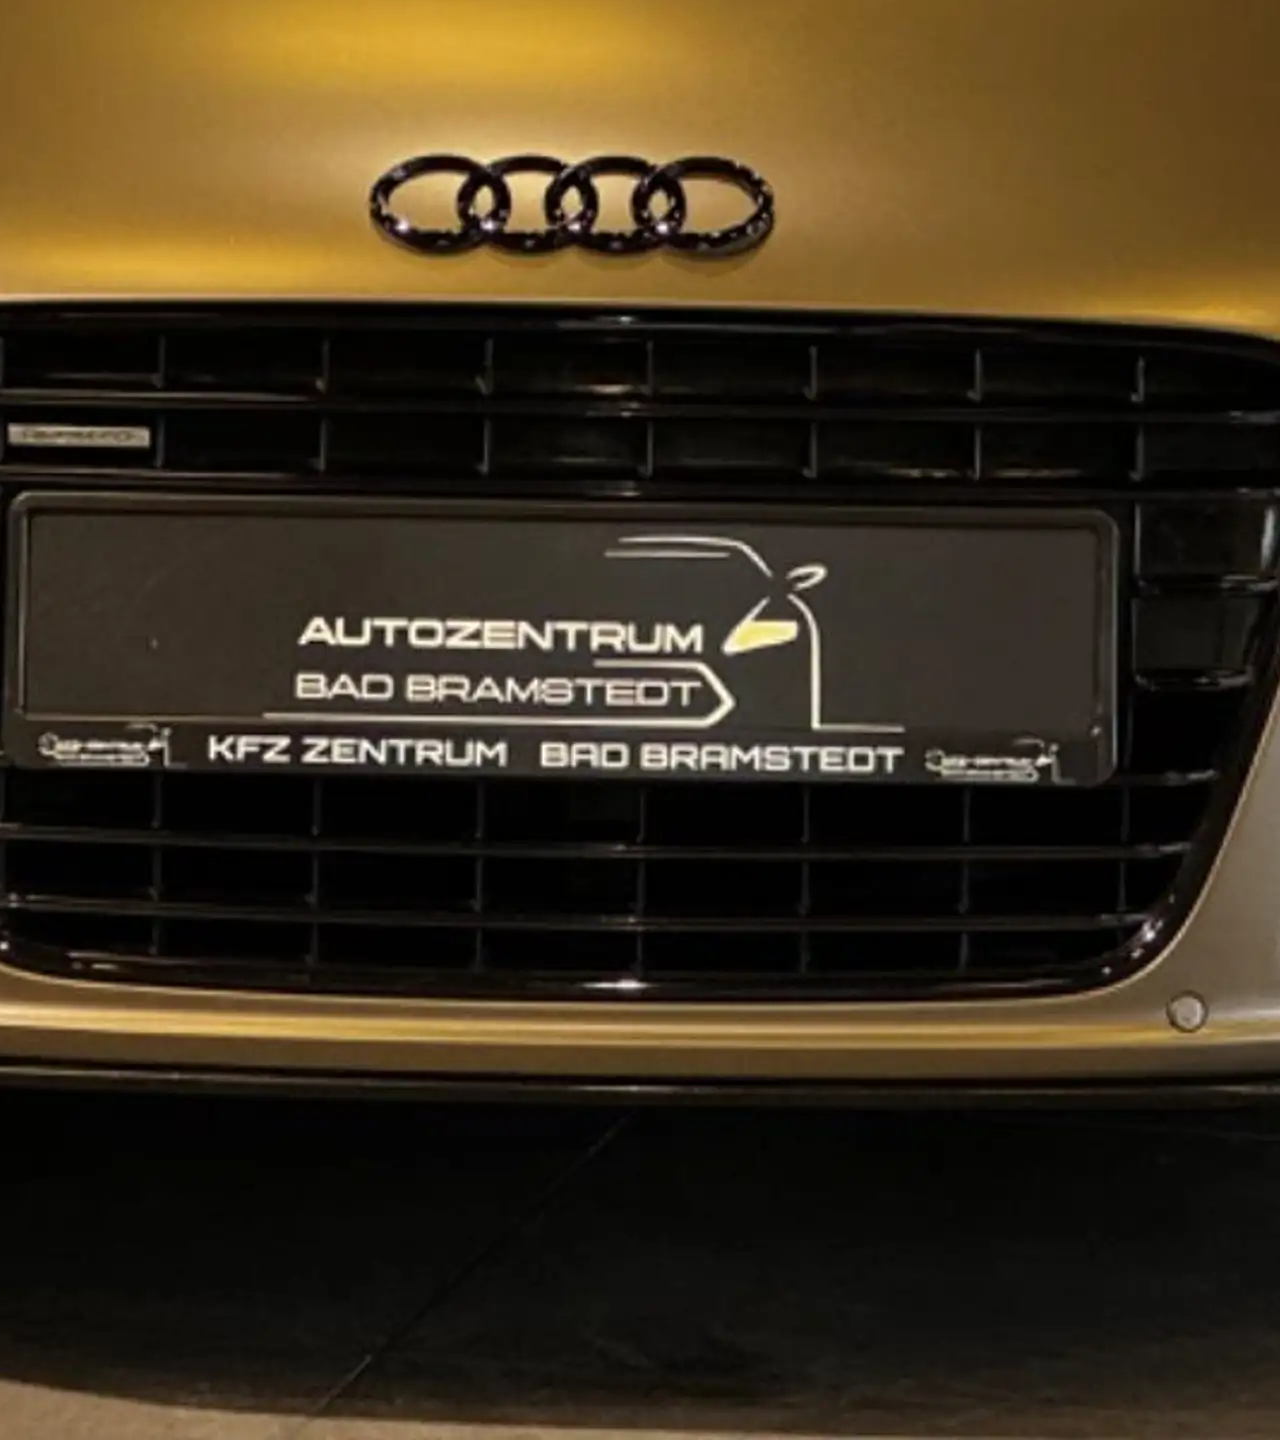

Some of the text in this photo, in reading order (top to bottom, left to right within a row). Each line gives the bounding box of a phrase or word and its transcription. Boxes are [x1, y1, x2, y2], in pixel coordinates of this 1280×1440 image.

[297, 616, 704, 654] AUTOZENTRUM
[295, 672, 703, 708] BAD BRAMSTEDT
[208, 734, 292, 764] KFZ
[300, 736, 508, 768] ZENTRUM
[540, 741, 630, 769] BAD
[640, 742, 905, 774] BRAMSTEDT
